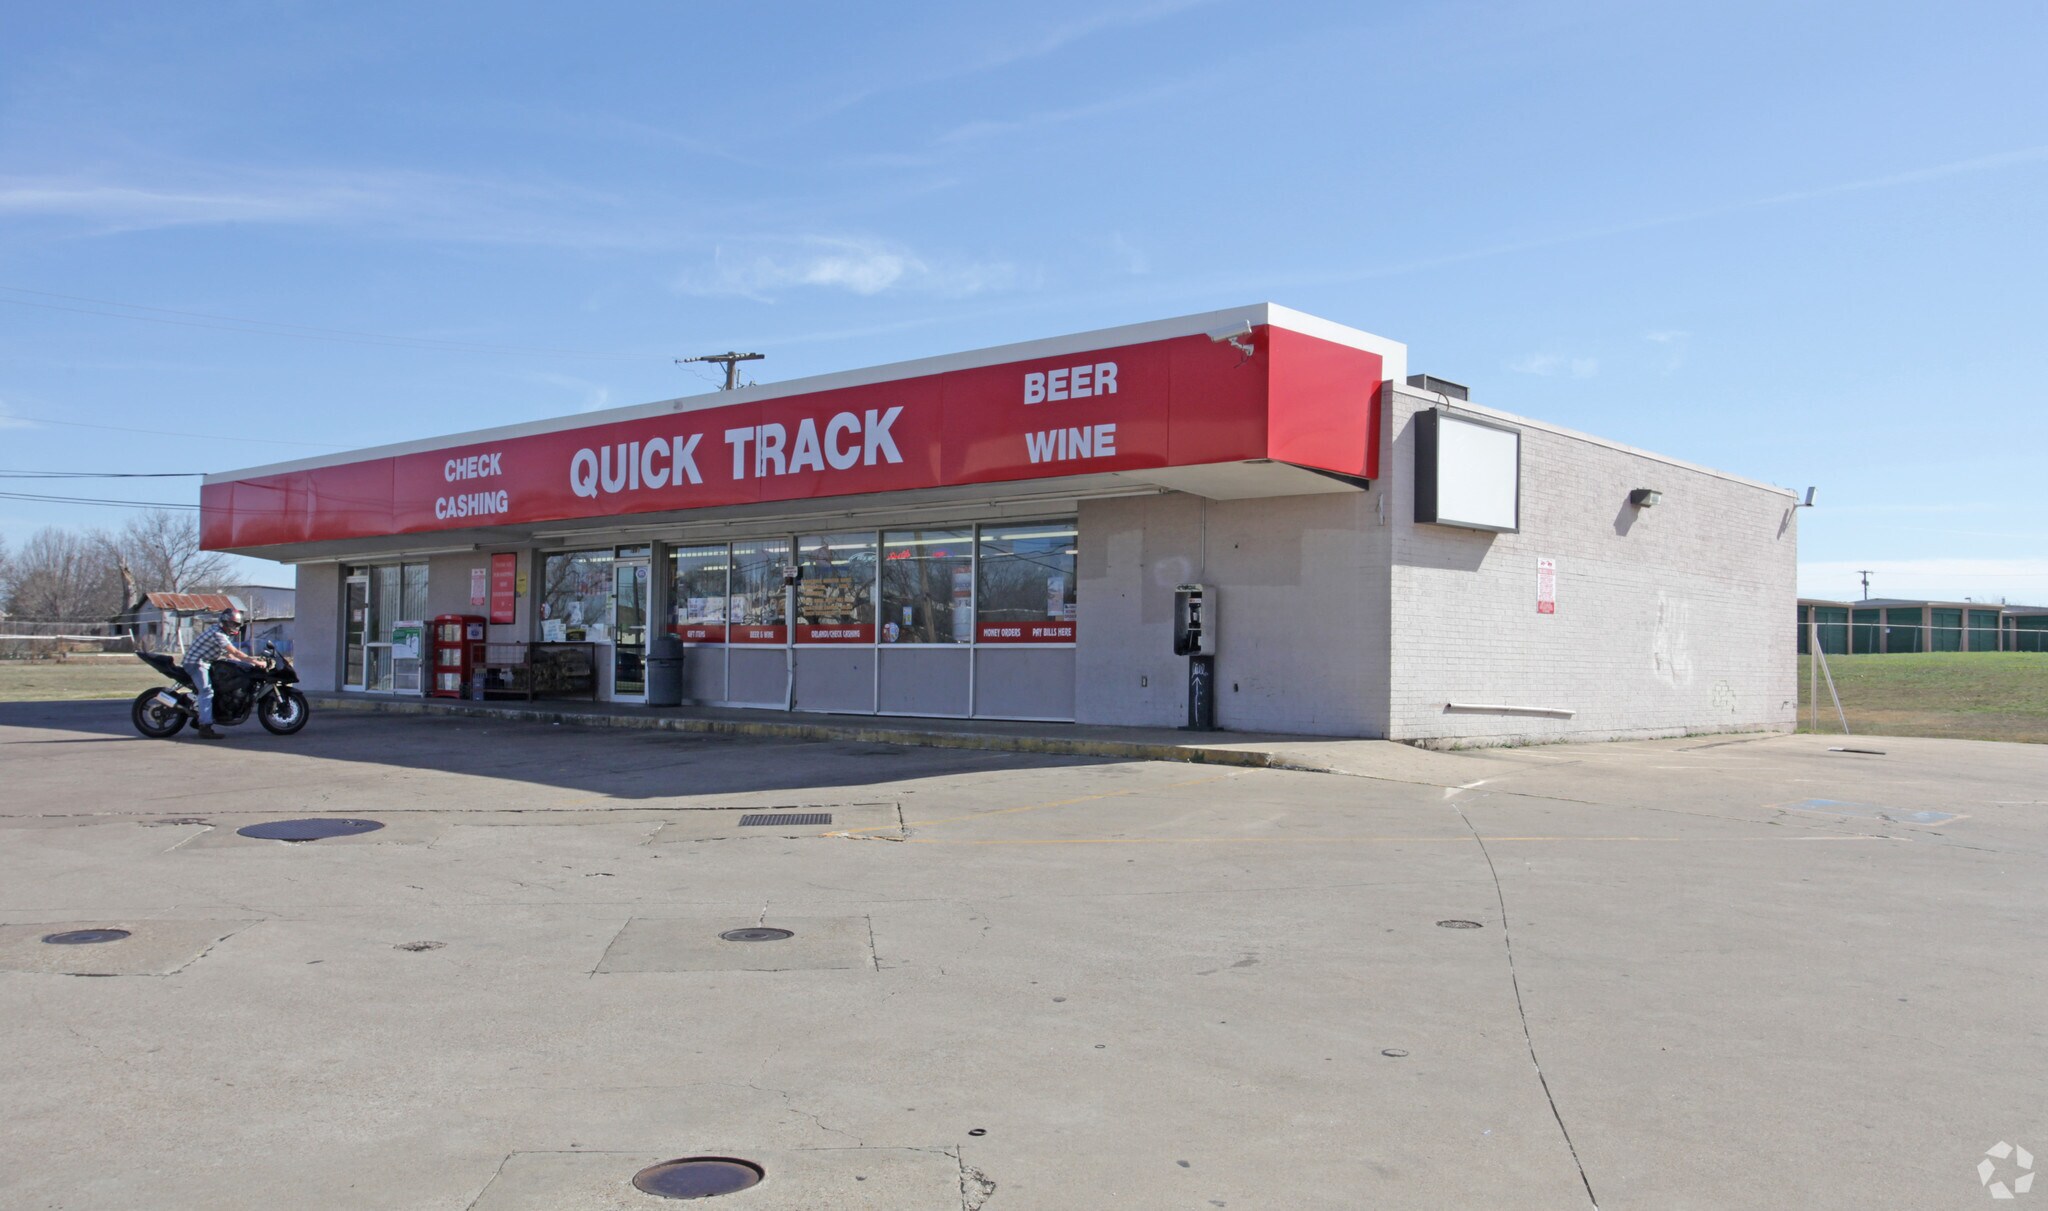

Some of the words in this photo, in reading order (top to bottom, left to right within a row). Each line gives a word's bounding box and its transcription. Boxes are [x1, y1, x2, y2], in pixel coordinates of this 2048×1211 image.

[1023, 361, 1118, 405] BEER
[569, 433, 702, 498] QUICK
[725, 406, 904, 480] TRACK
[1026, 424, 1115, 463] WINE
[444, 452, 502, 482] CHECK
[436, 491, 507, 519] CASHING
[750, 631, 760, 639] BEER
[764, 631, 774, 639] WINE
[983, 628, 1000, 637] MONEY
[1001, 628, 1021, 637] ORDERS
[1032, 628, 1042, 637] PAY
[1043, 628, 1057, 637] BILLS
[1057, 627, 1072, 637] HERE
